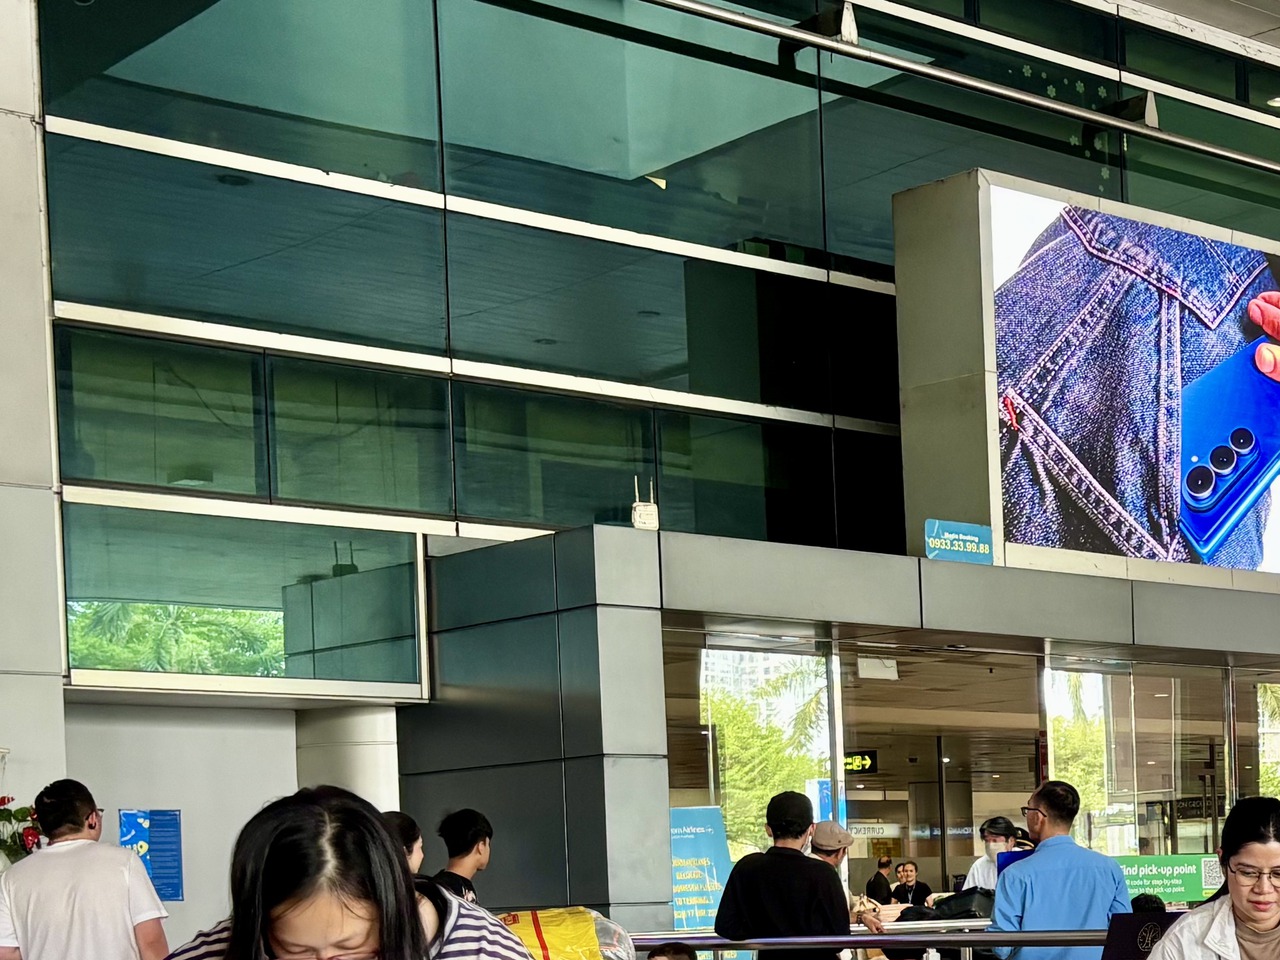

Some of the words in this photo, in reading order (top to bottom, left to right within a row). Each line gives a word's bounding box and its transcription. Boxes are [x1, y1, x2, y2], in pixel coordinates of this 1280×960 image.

[929, 538, 990, 554] 0933.33.99.88
[1139, 863, 1173, 878] pick-up
[1174, 863, 1197, 877] point
